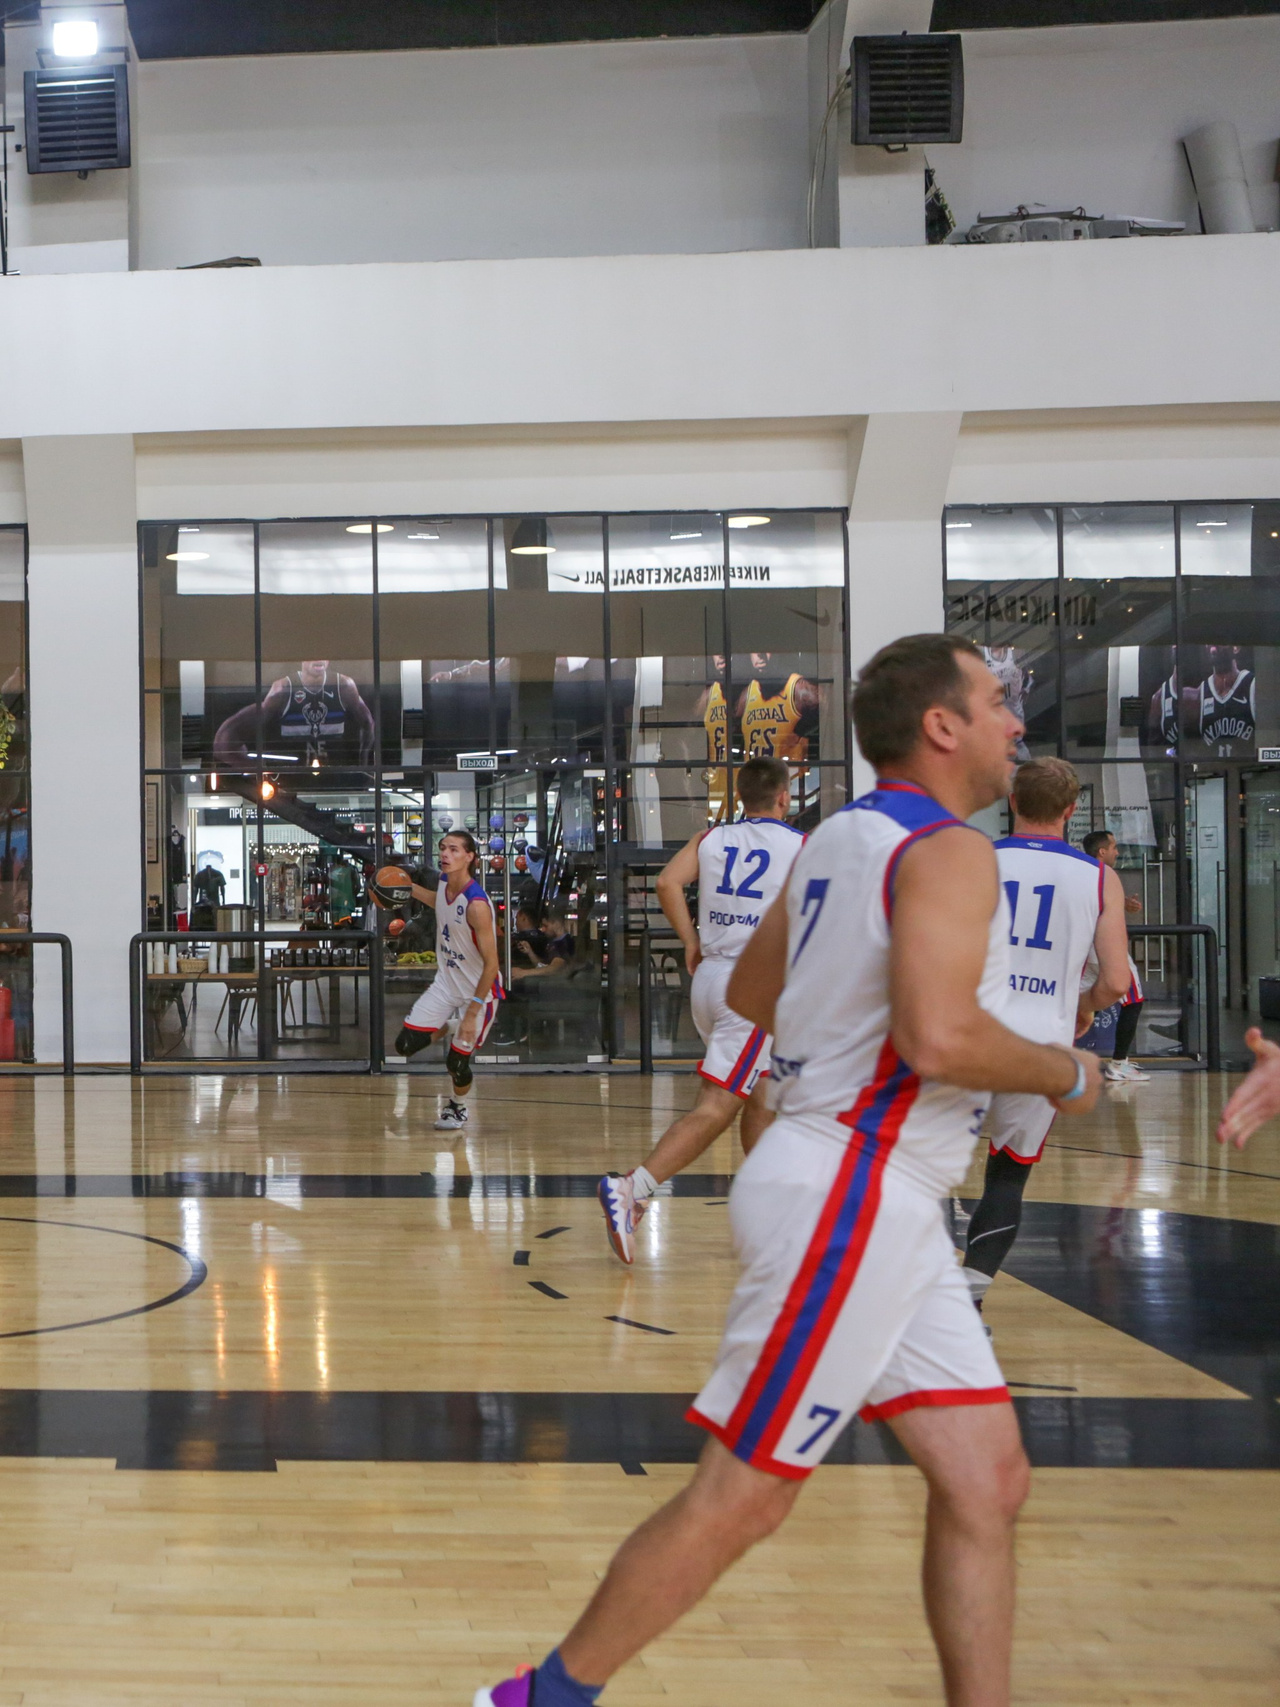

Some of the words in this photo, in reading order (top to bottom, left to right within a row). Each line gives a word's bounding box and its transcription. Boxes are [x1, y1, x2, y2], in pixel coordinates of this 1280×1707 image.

[461, 759, 494, 768] ВЫХОД
[715, 846, 771, 900] 12
[441, 923, 451, 943] 4
[791, 878, 832, 970] 7
[794, 1404, 842, 1454] 7
